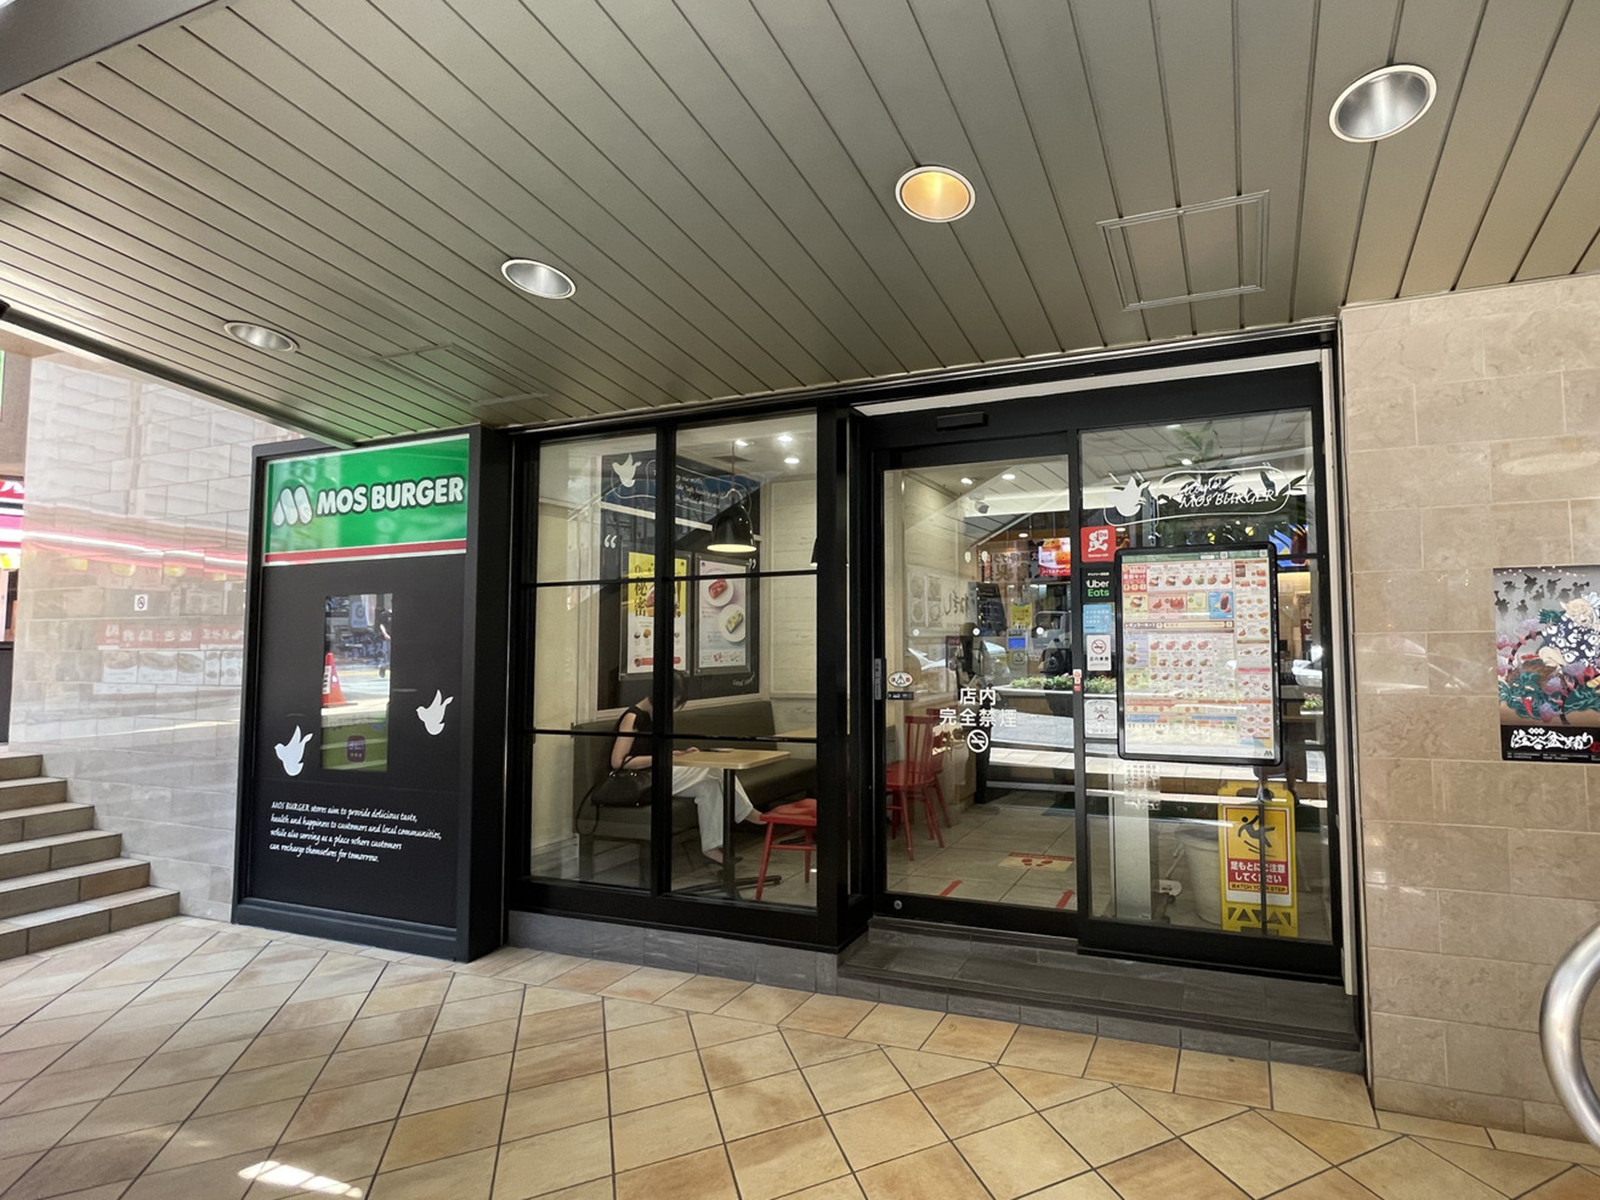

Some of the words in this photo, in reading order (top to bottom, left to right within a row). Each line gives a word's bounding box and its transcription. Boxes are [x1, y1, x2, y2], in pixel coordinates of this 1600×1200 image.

[315, 485, 368, 516] MOS
[370, 475, 465, 511] BURGER
[1179, 492, 1215, 508] MOS
[1215, 489, 1276, 506] BURGER
[1086, 580, 1109, 588] Uber
[1088, 589, 1110, 597] Eats
[959, 687, 997, 705] 店内
[939, 708, 1017, 727] 完全禁煙
[341, 807, 347, 815] to
[347, 808, 371, 819] provide
[368, 824, 381, 833] and
[381, 824, 398, 835] local
[337, 848, 347, 862] for
